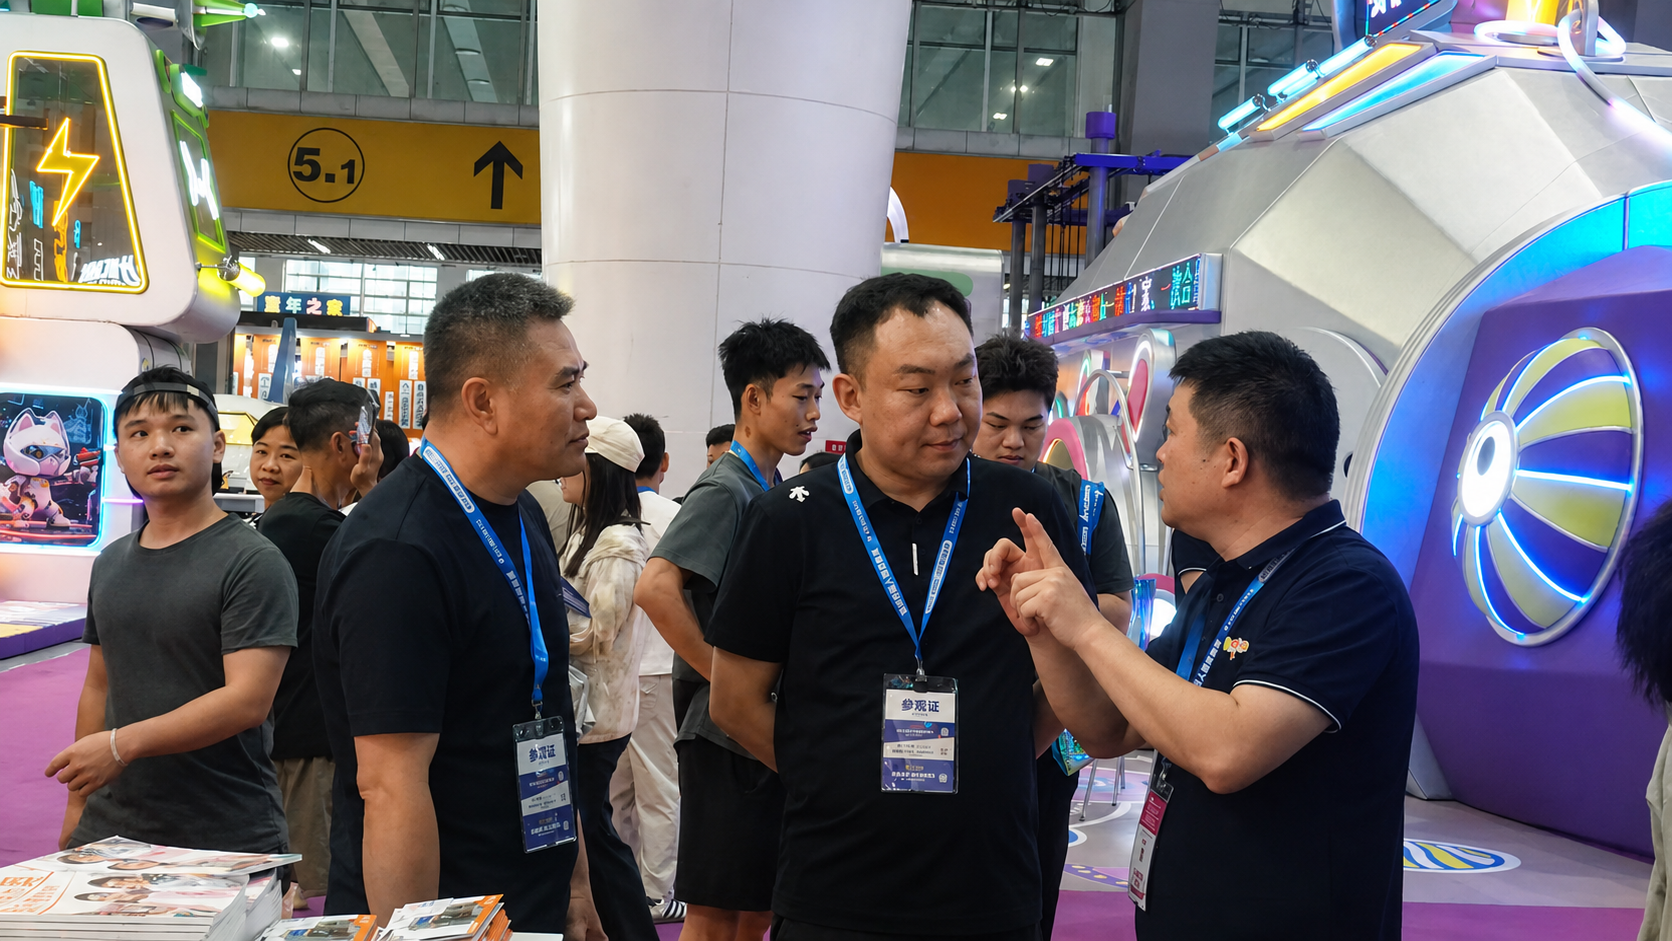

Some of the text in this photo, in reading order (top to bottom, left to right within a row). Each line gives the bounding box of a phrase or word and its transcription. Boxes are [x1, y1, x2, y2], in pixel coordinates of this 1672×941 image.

[292, 146, 356, 185] 5.1
[900, 698, 940, 713] 参观证
